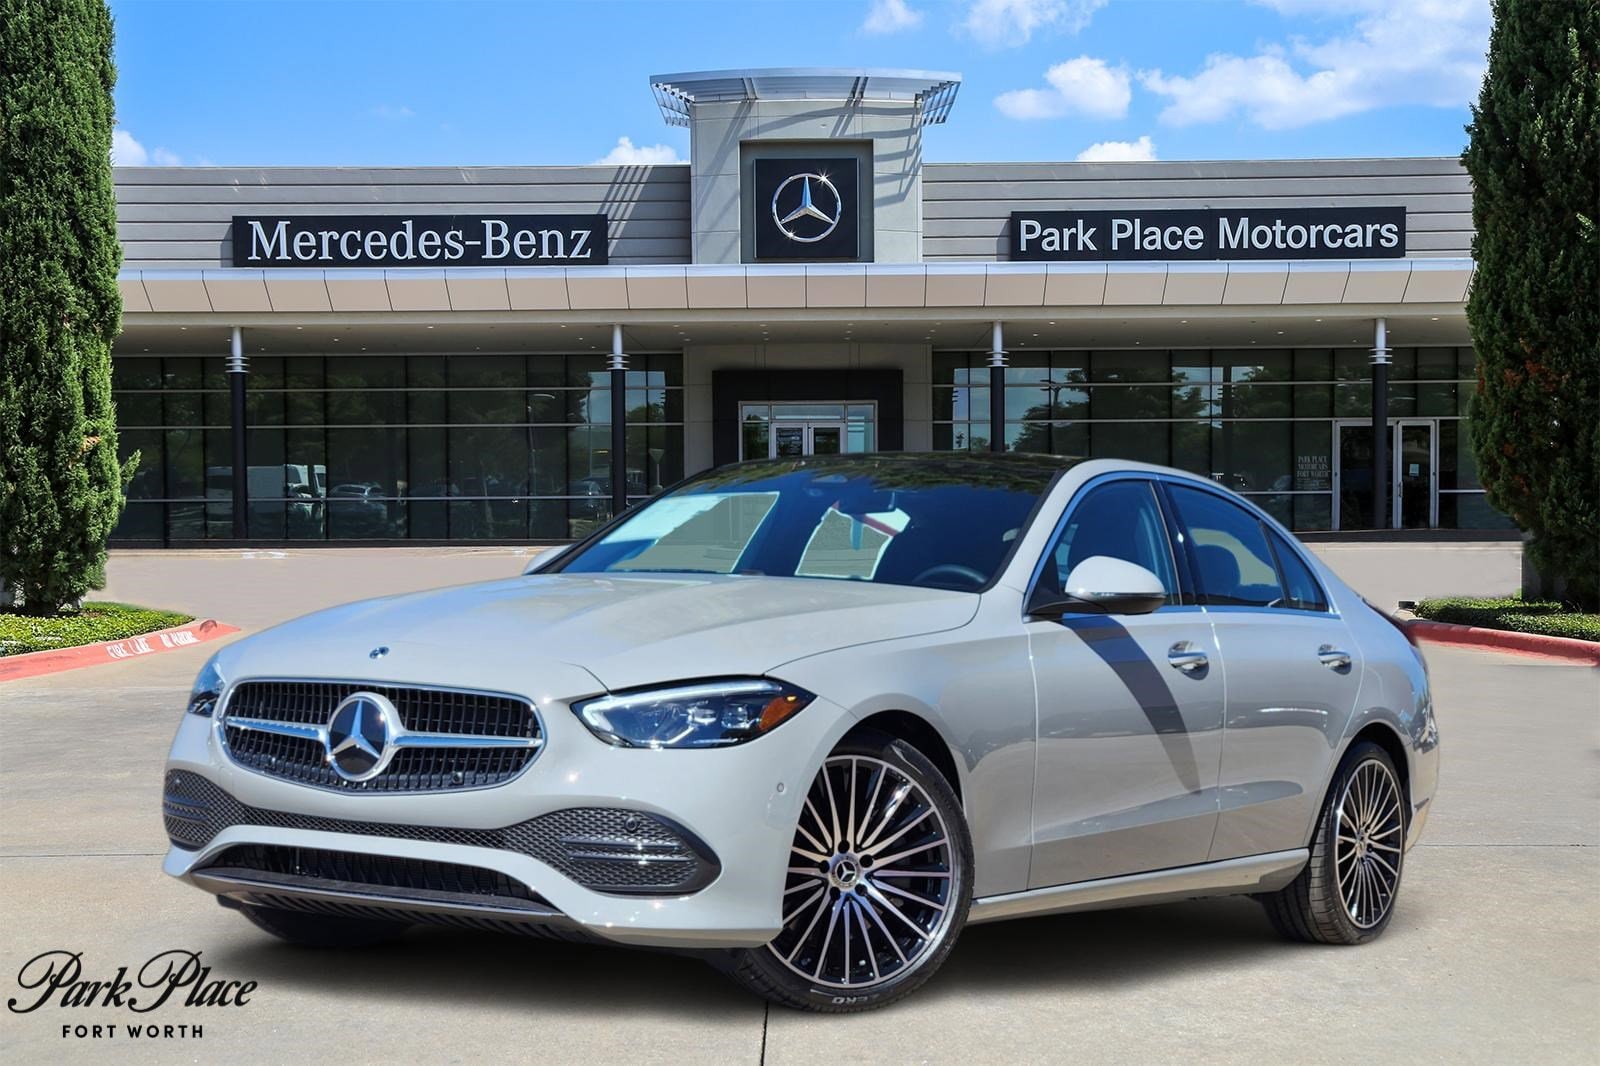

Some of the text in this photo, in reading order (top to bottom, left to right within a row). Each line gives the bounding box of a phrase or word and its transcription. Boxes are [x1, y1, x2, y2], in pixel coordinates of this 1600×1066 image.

[247, 220, 592, 260] Mercedes-Benz
[1019, 217, 1399, 252] Park Place Motorcars
